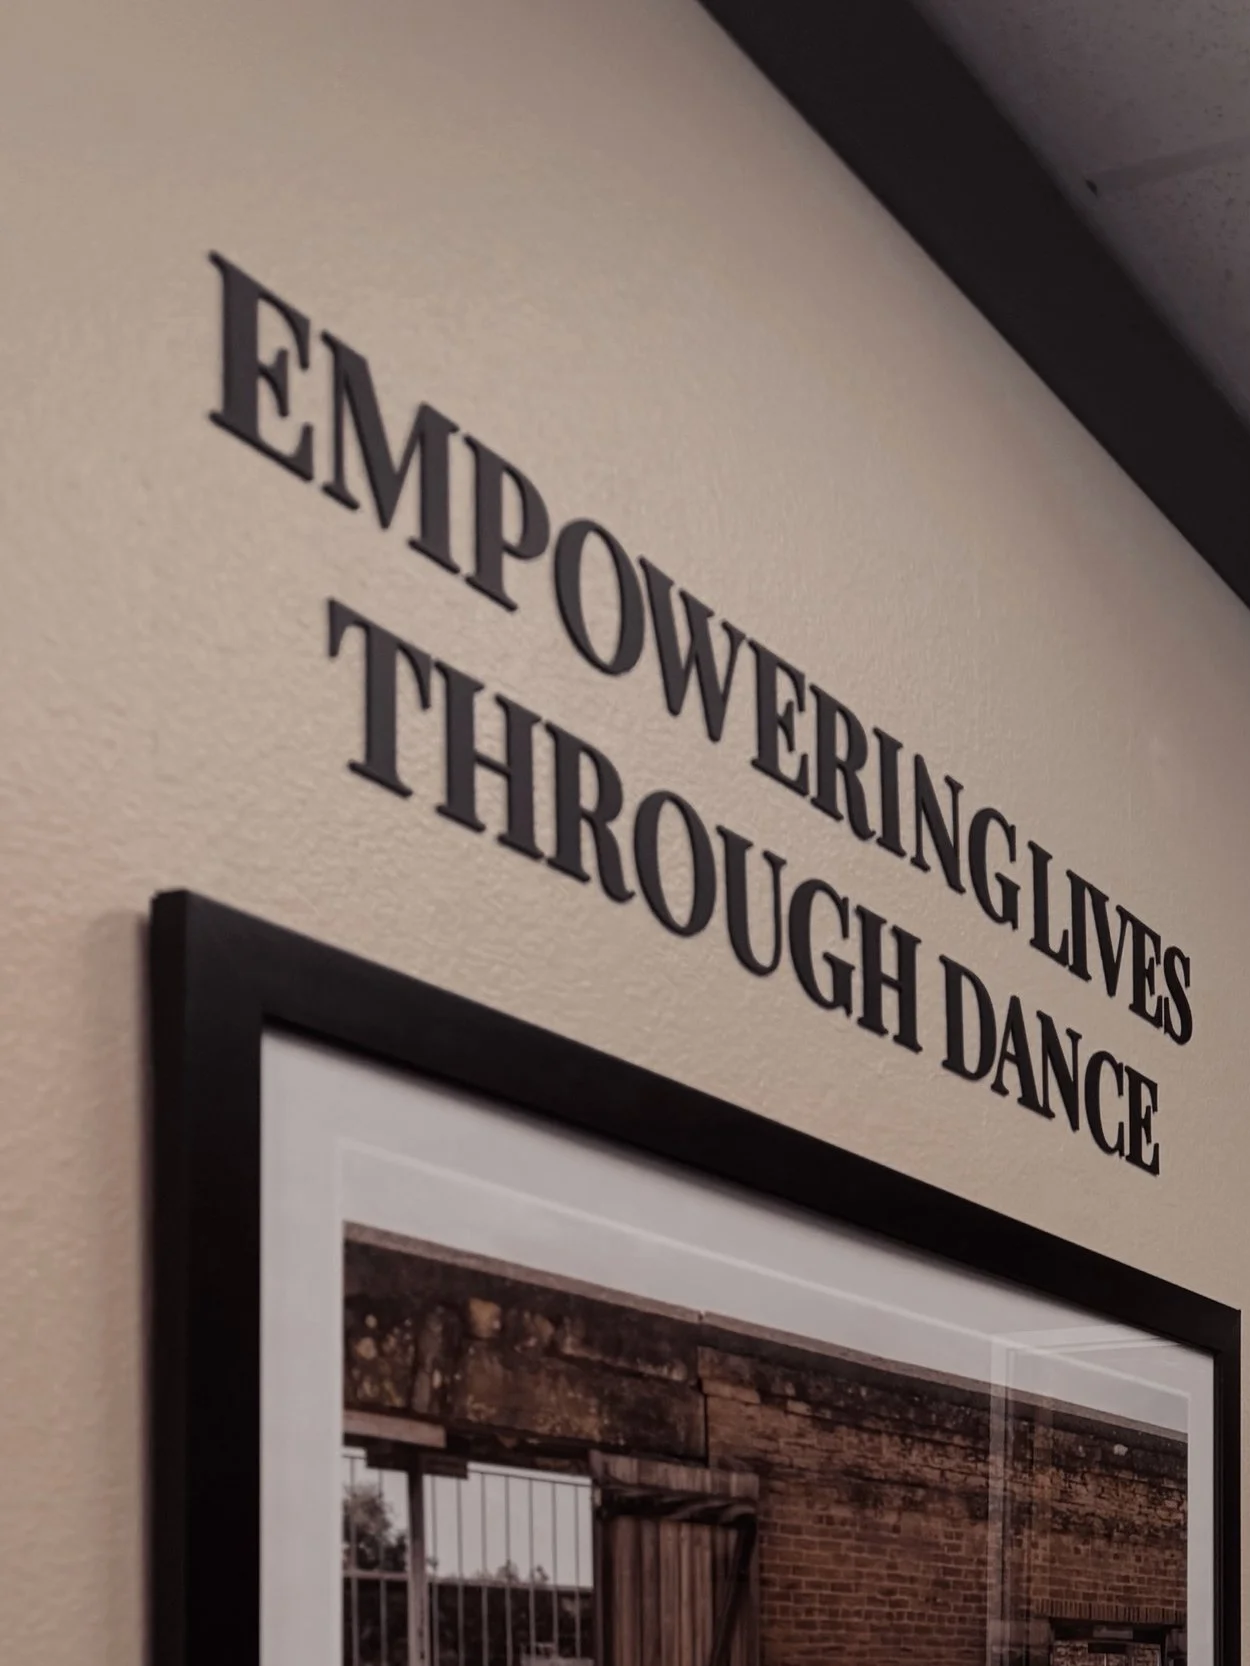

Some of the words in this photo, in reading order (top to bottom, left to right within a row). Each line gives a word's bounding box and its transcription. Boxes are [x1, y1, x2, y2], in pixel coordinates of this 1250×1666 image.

[208, 250, 1021, 933] EMPOWERING
[1026, 838, 1194, 1047] LIVES
[326, 597, 925, 1056] THROUGH
[938, 953, 1161, 1178] DANCE
